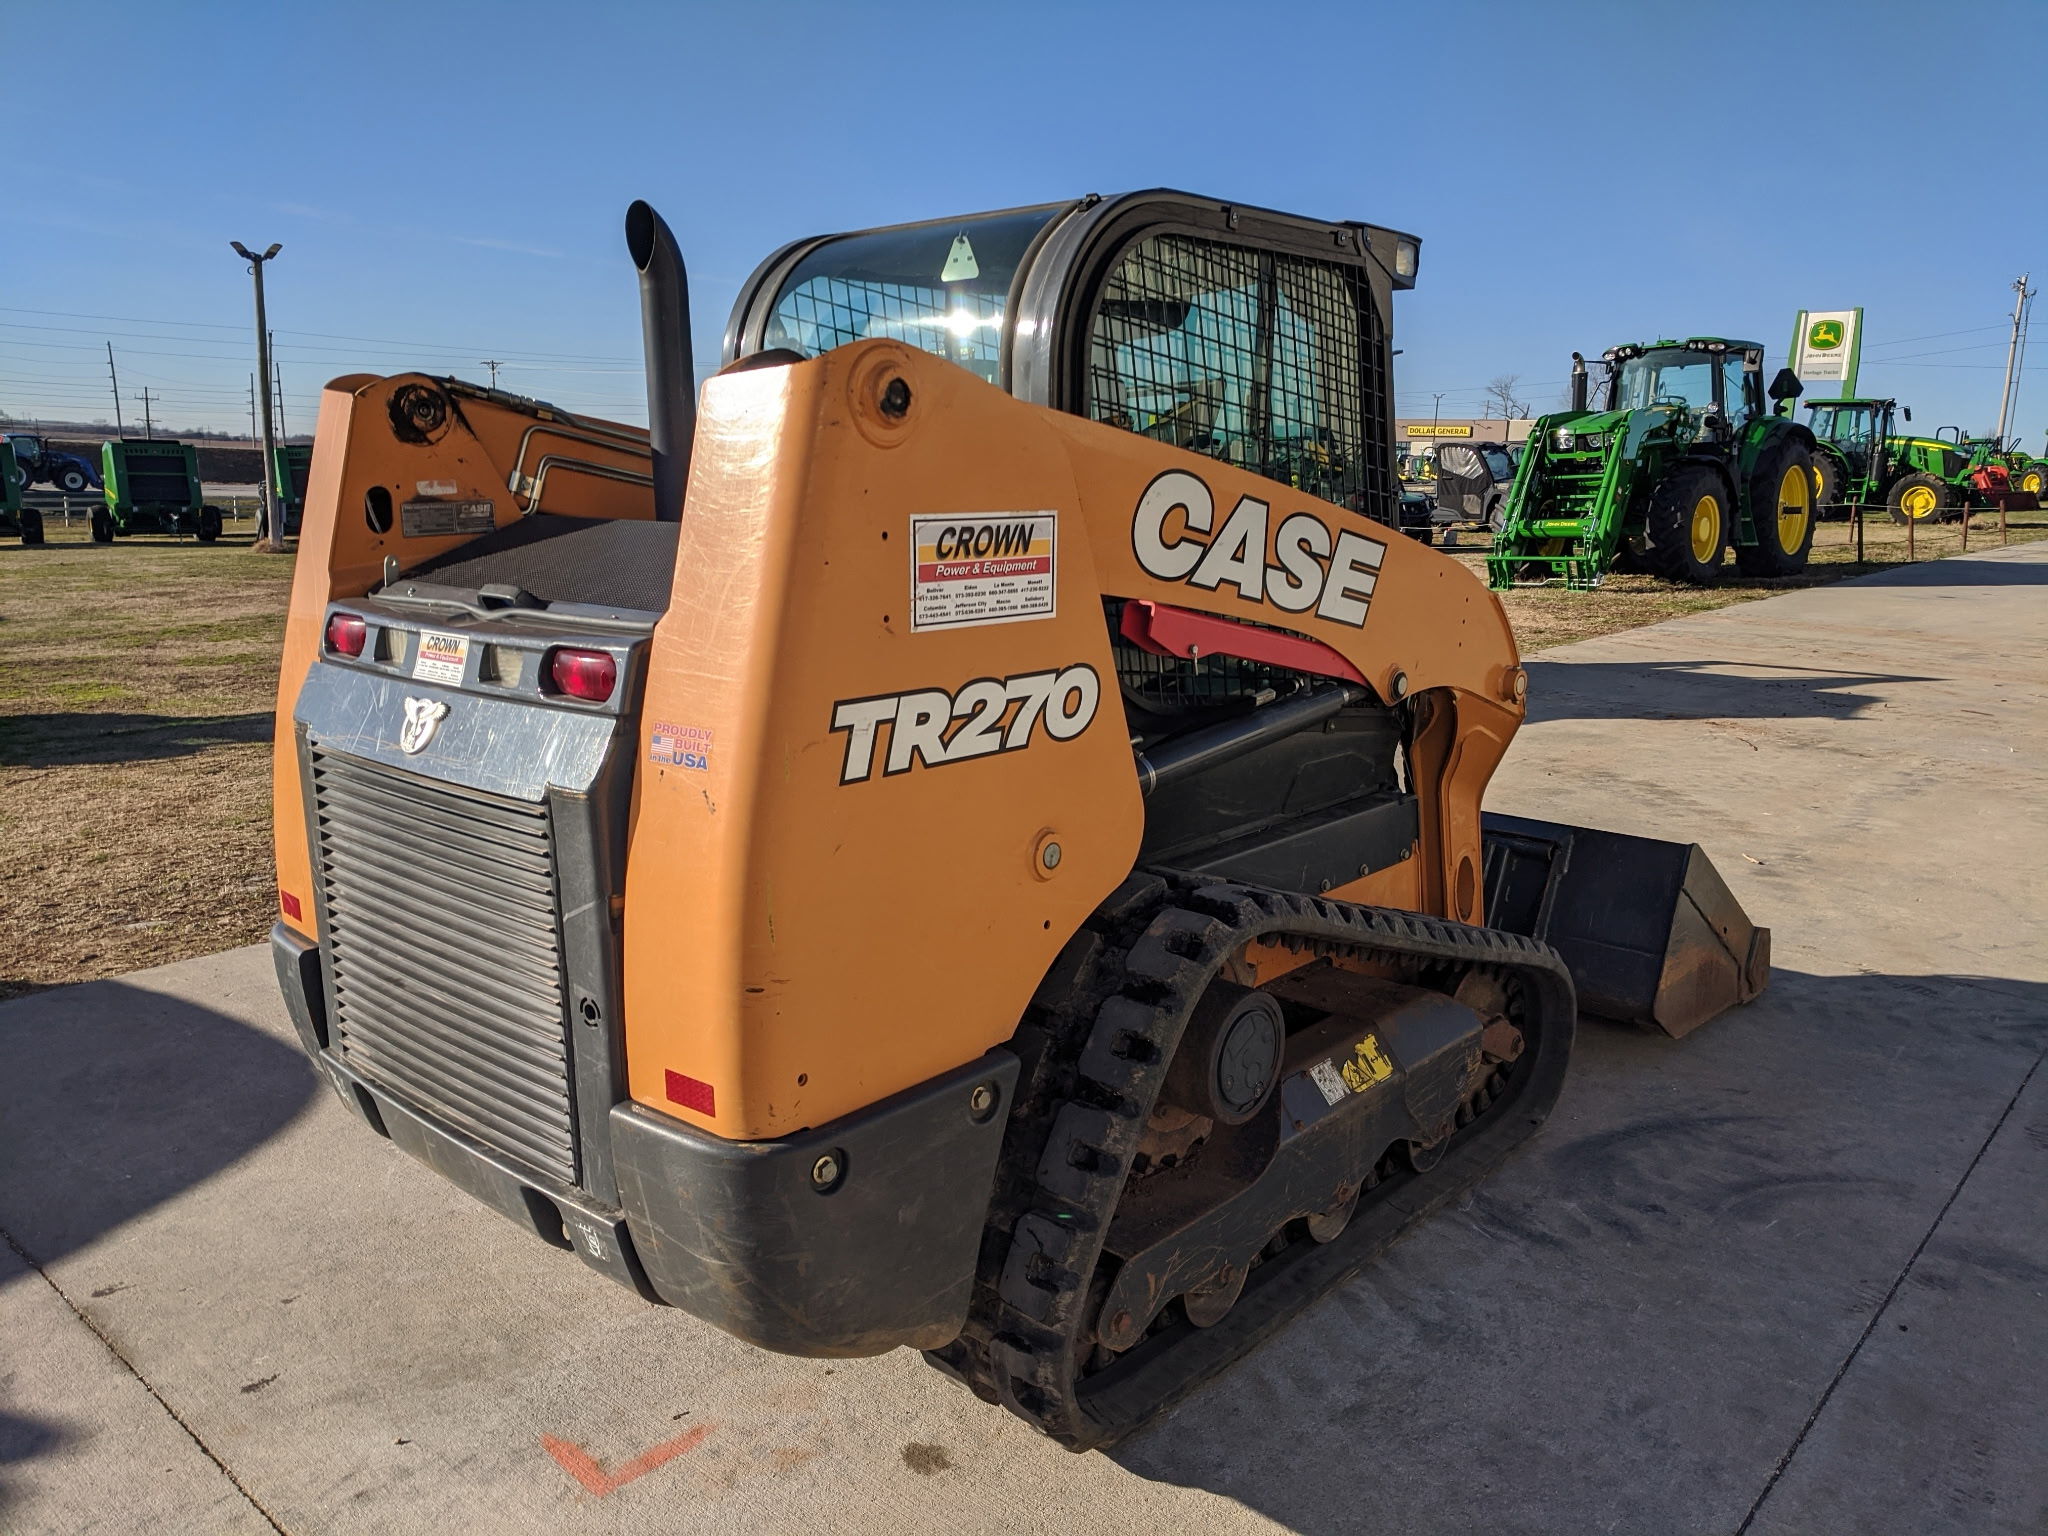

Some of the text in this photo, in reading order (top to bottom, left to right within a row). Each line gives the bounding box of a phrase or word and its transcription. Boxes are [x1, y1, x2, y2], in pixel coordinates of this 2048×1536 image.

[1409, 427, 1435, 435] DOLLAR
[935, 523, 1035, 560] CROWN
[1131, 468, 1388, 629] CASE
[935, 559, 1038, 577] Power & Equipment
[426, 635, 461, 655] CROWN
[654, 722, 712, 741] PROUDLY
[829, 662, 1101, 787] TR270
[674, 738, 711, 754] BUILT
[649, 751, 708, 770] in the USA
